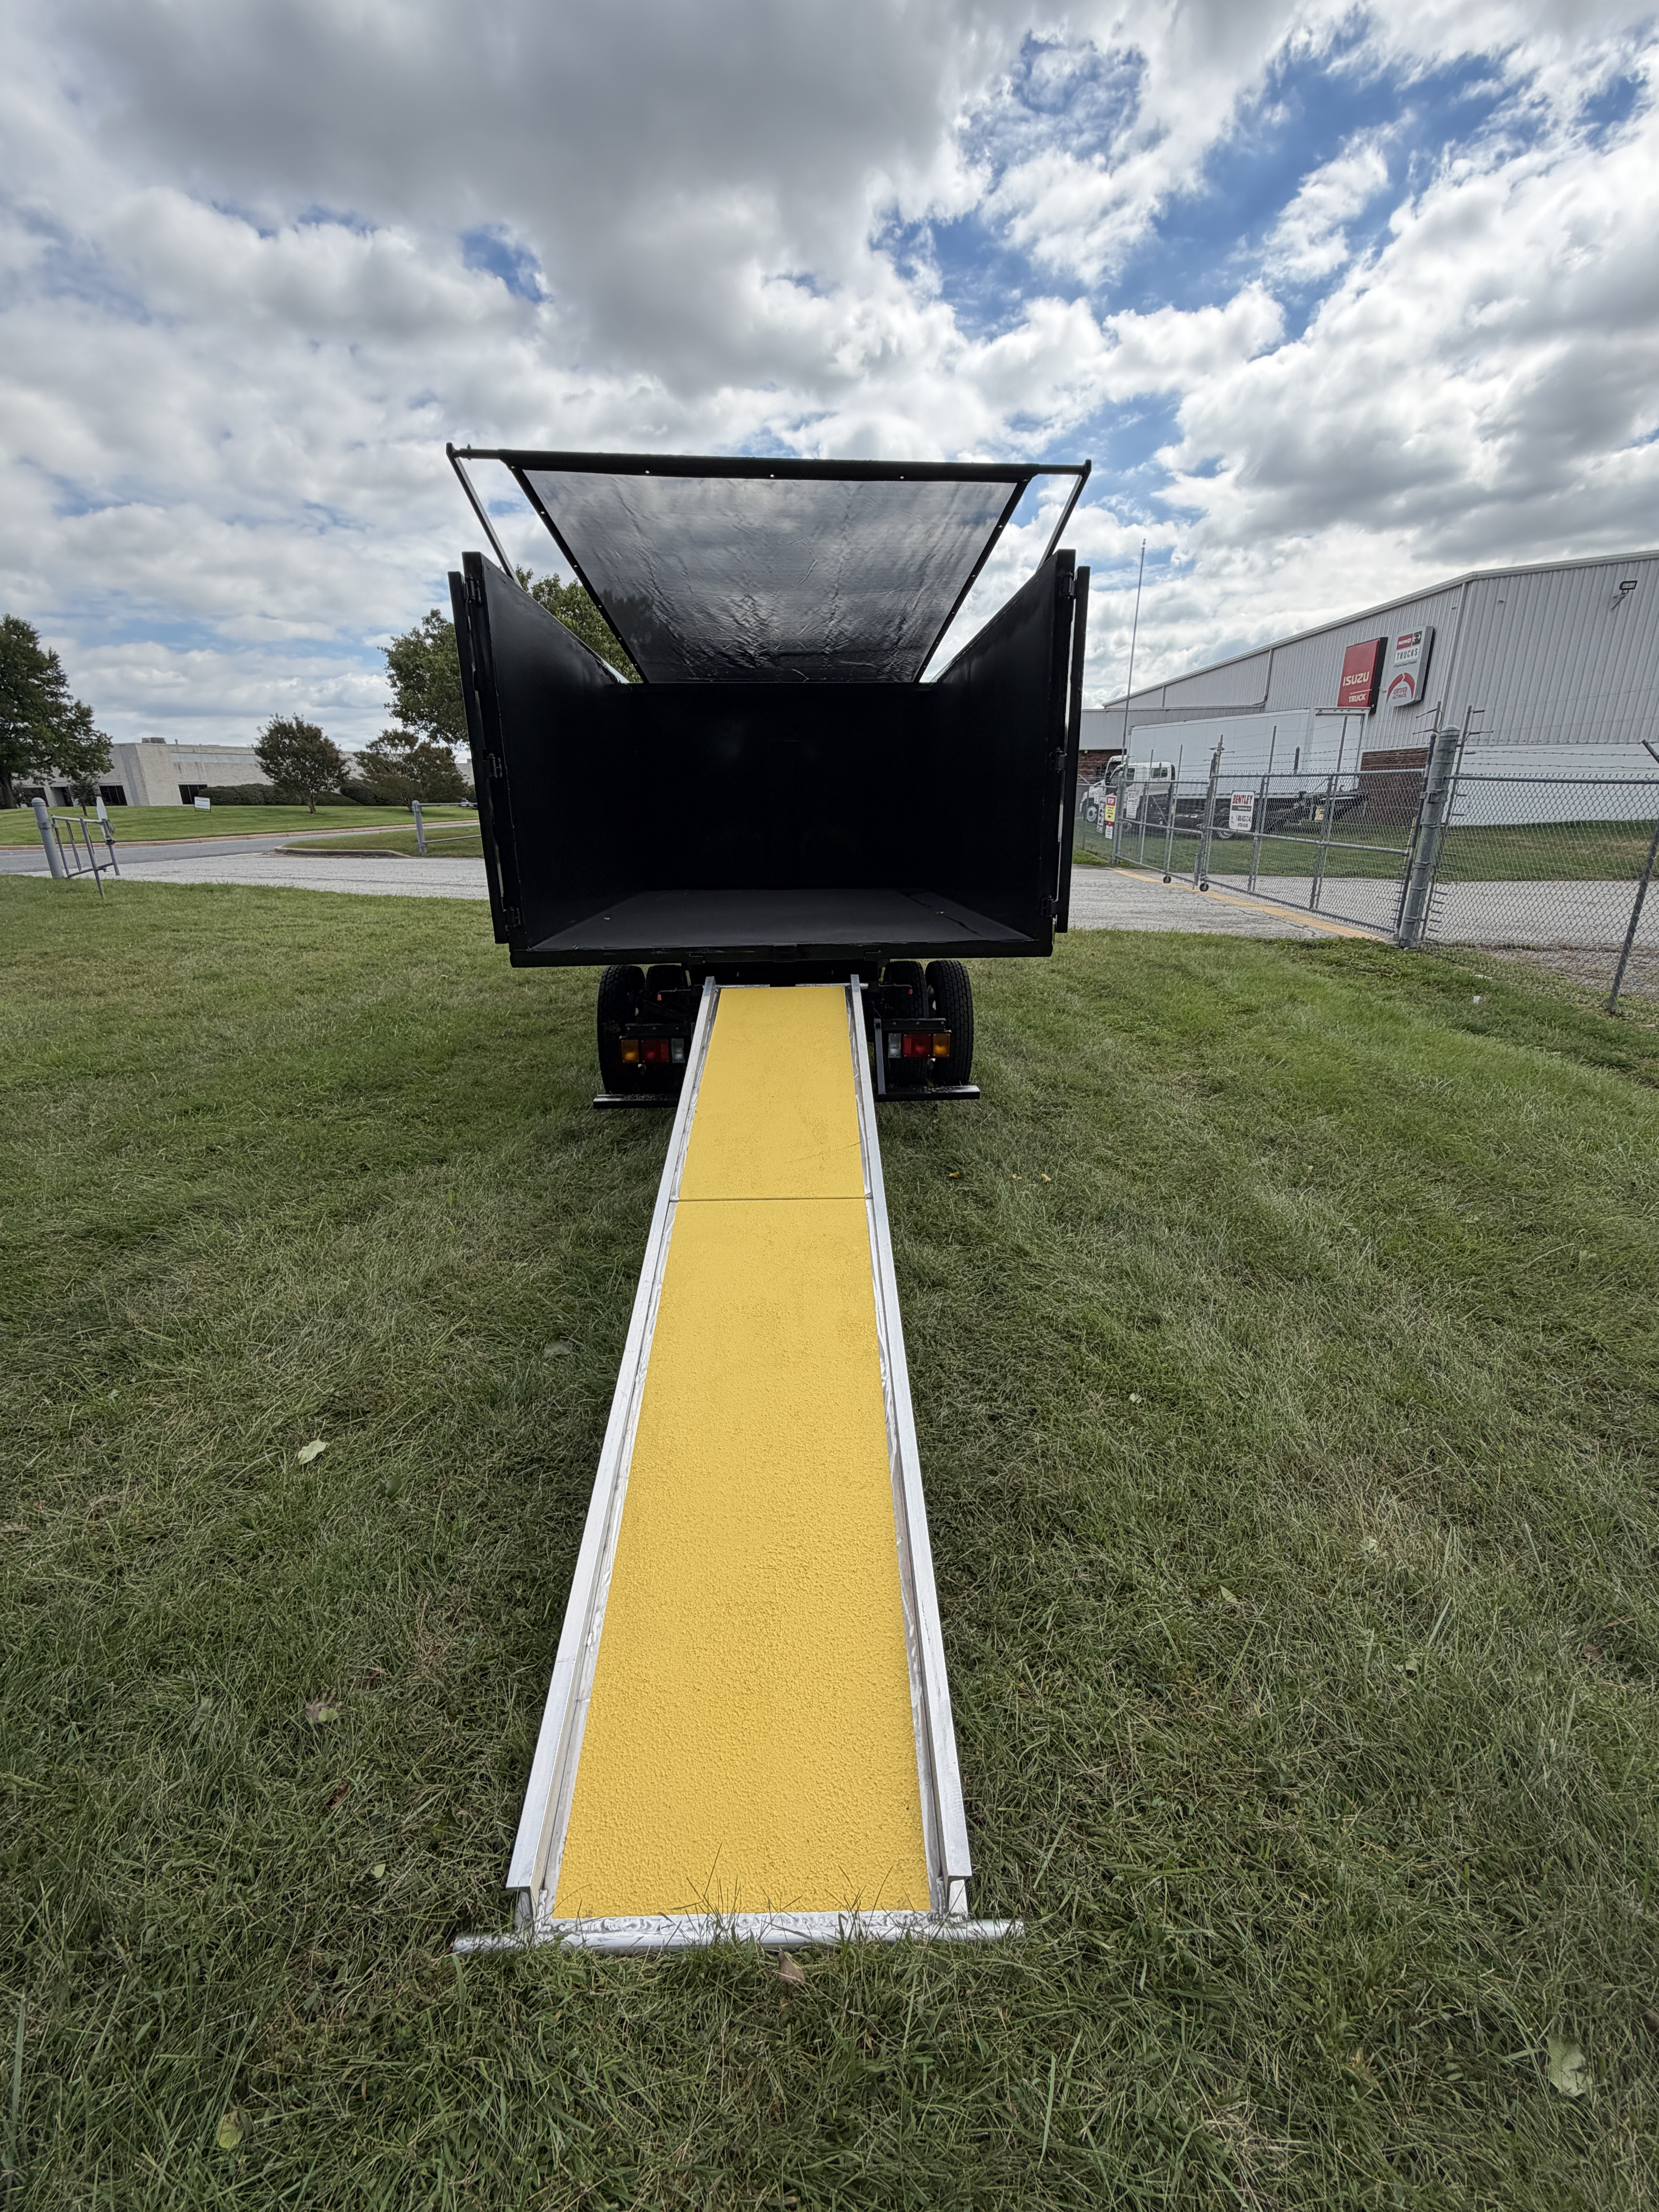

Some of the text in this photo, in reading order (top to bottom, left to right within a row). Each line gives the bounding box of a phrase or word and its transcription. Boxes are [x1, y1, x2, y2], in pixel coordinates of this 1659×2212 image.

[1397, 648, 1418, 660] TRUCKS
[1343, 671, 1370, 687] ISUZU
[1349, 693, 1366, 703] TRUCK
[1232, 794, 1253, 804] BENTLEY
